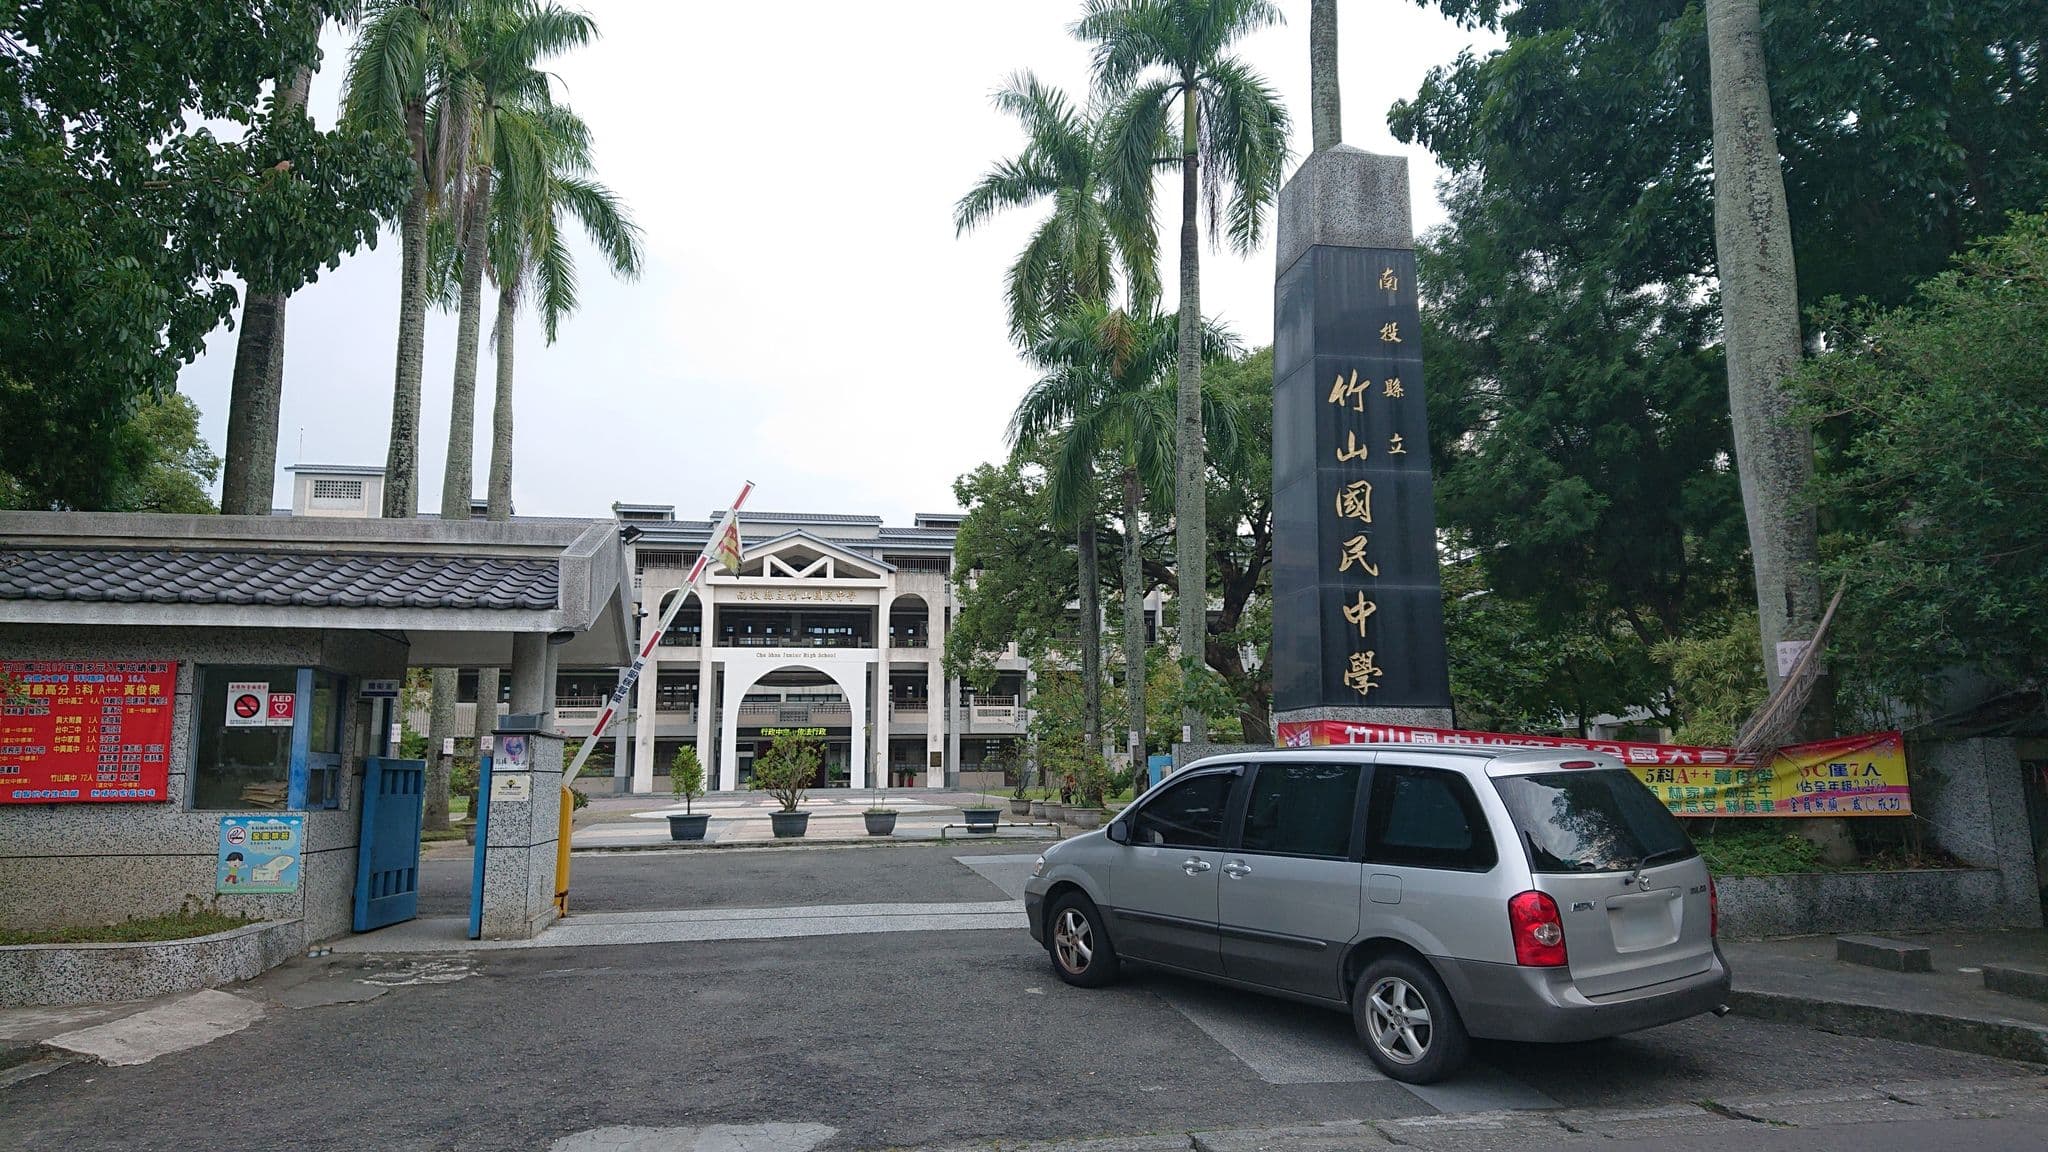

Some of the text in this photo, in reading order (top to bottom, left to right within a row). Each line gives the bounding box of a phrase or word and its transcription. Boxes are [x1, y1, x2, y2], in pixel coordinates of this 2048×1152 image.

[1378, 266, 1407, 456] 南投縣立
[1328, 368, 1383, 696] 竹山國民中學
[272, 695, 292, 703] AED
